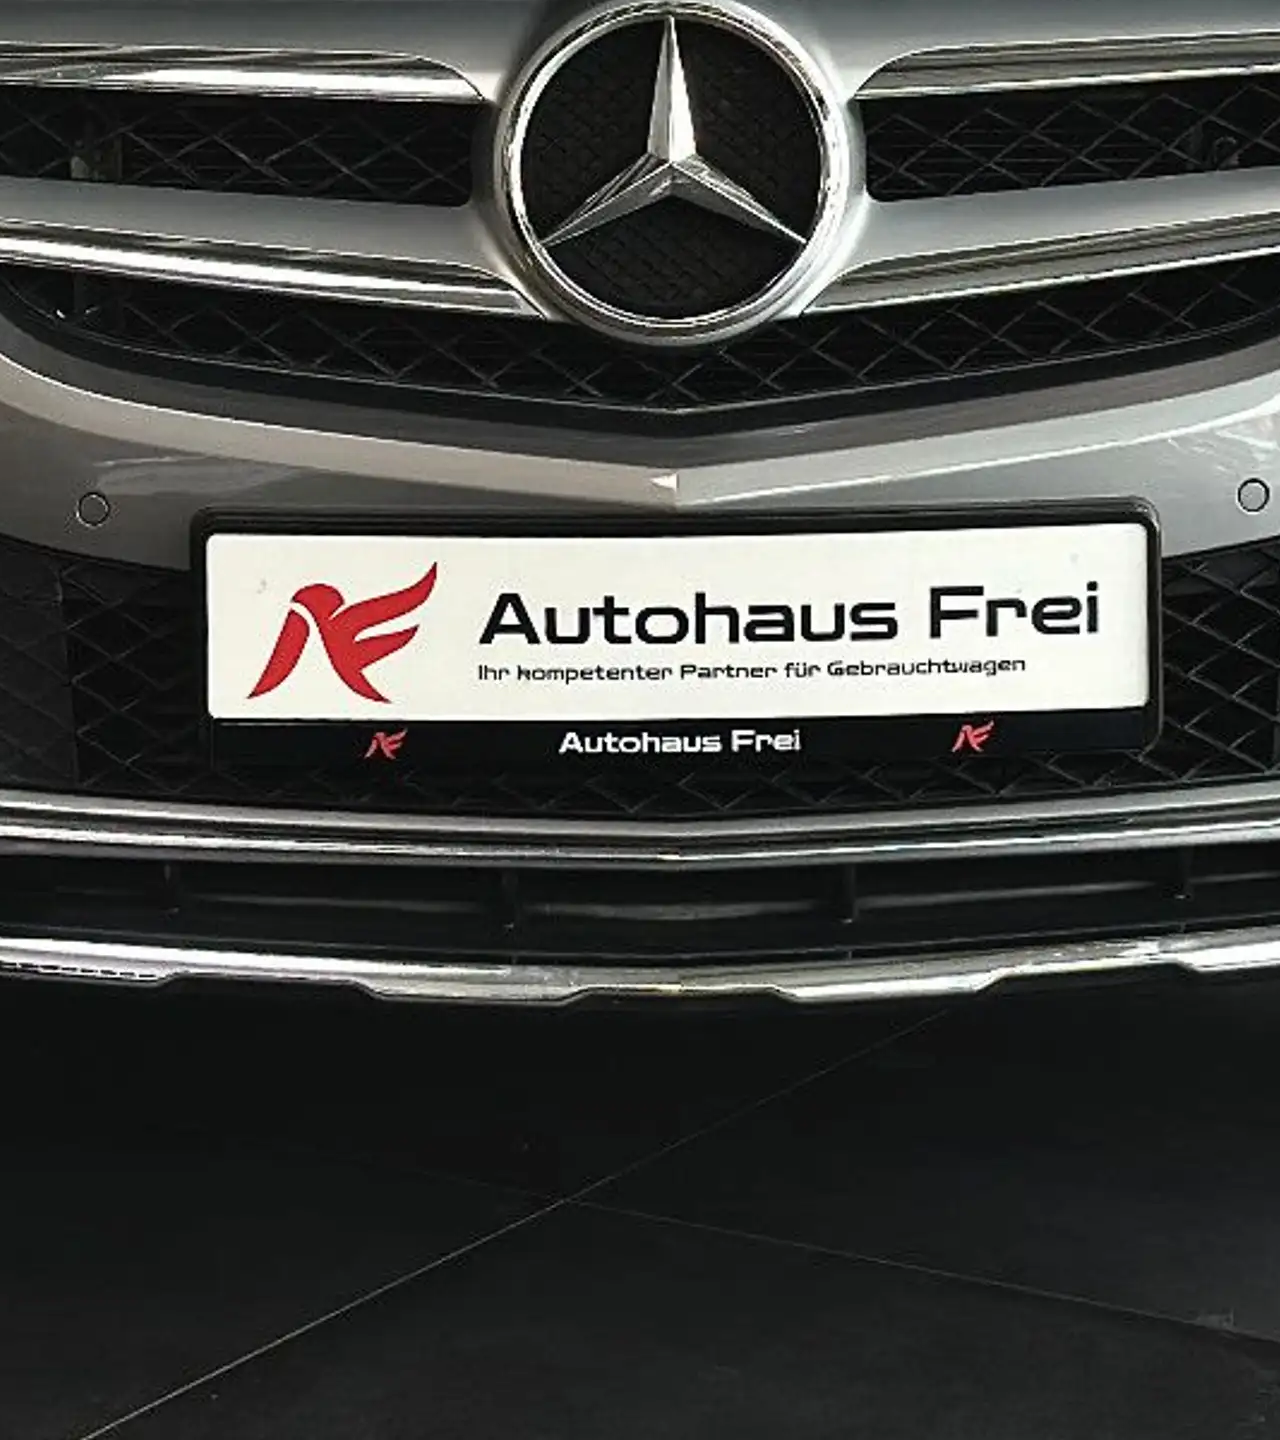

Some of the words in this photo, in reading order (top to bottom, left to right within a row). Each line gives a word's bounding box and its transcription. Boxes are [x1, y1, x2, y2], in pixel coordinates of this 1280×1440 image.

[478, 591, 899, 645] Autohaus
[929, 580, 1099, 639] Frei
[478, 664, 511, 681] Ihr
[516, 664, 673, 686] kompetenter
[679, 663, 778, 681] Partner
[783, 660, 822, 679] für
[826, 657, 1026, 678] Gebrauchtwagen
[558, 731, 723, 754] Autohaus
[731, 729, 801, 753] Frei
